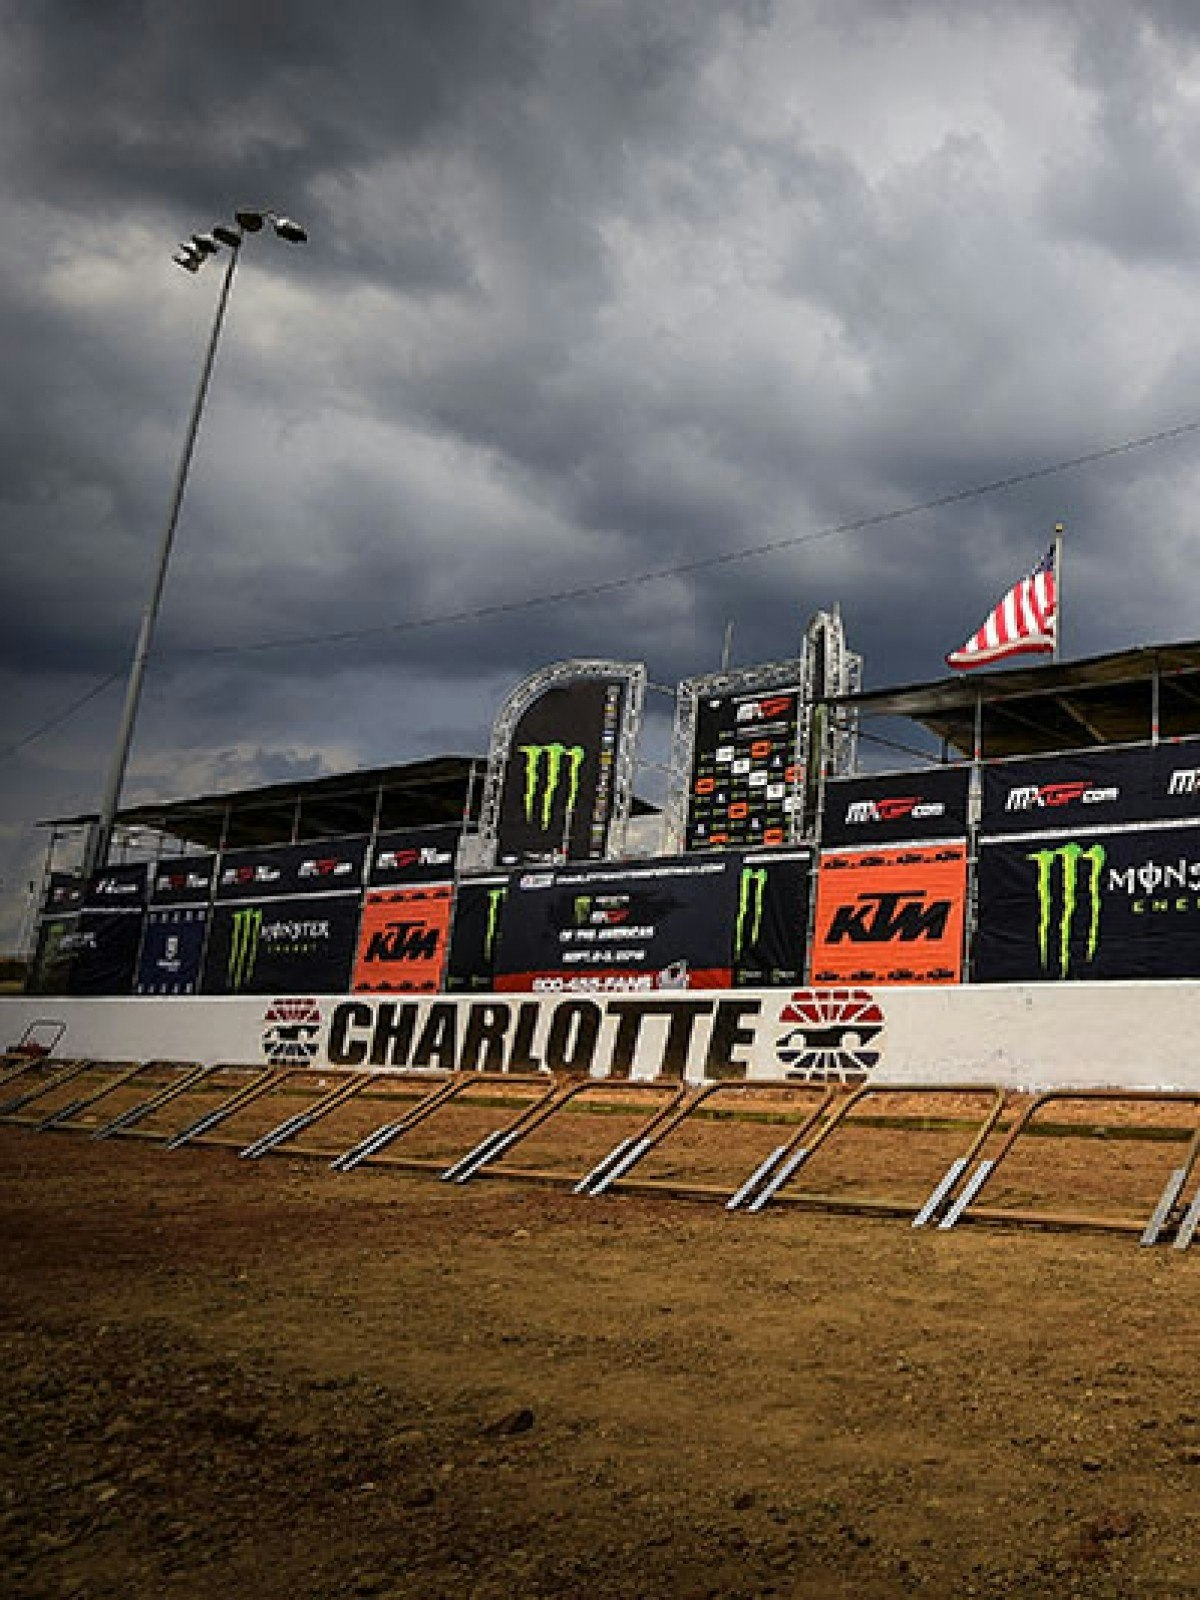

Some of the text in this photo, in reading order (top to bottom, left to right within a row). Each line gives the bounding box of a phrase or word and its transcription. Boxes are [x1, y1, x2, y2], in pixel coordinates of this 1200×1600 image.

[364, 920, 440, 962] KTM
[824, 890, 952, 944] KTM
[327, 998, 763, 1081] CHARLOTTE
